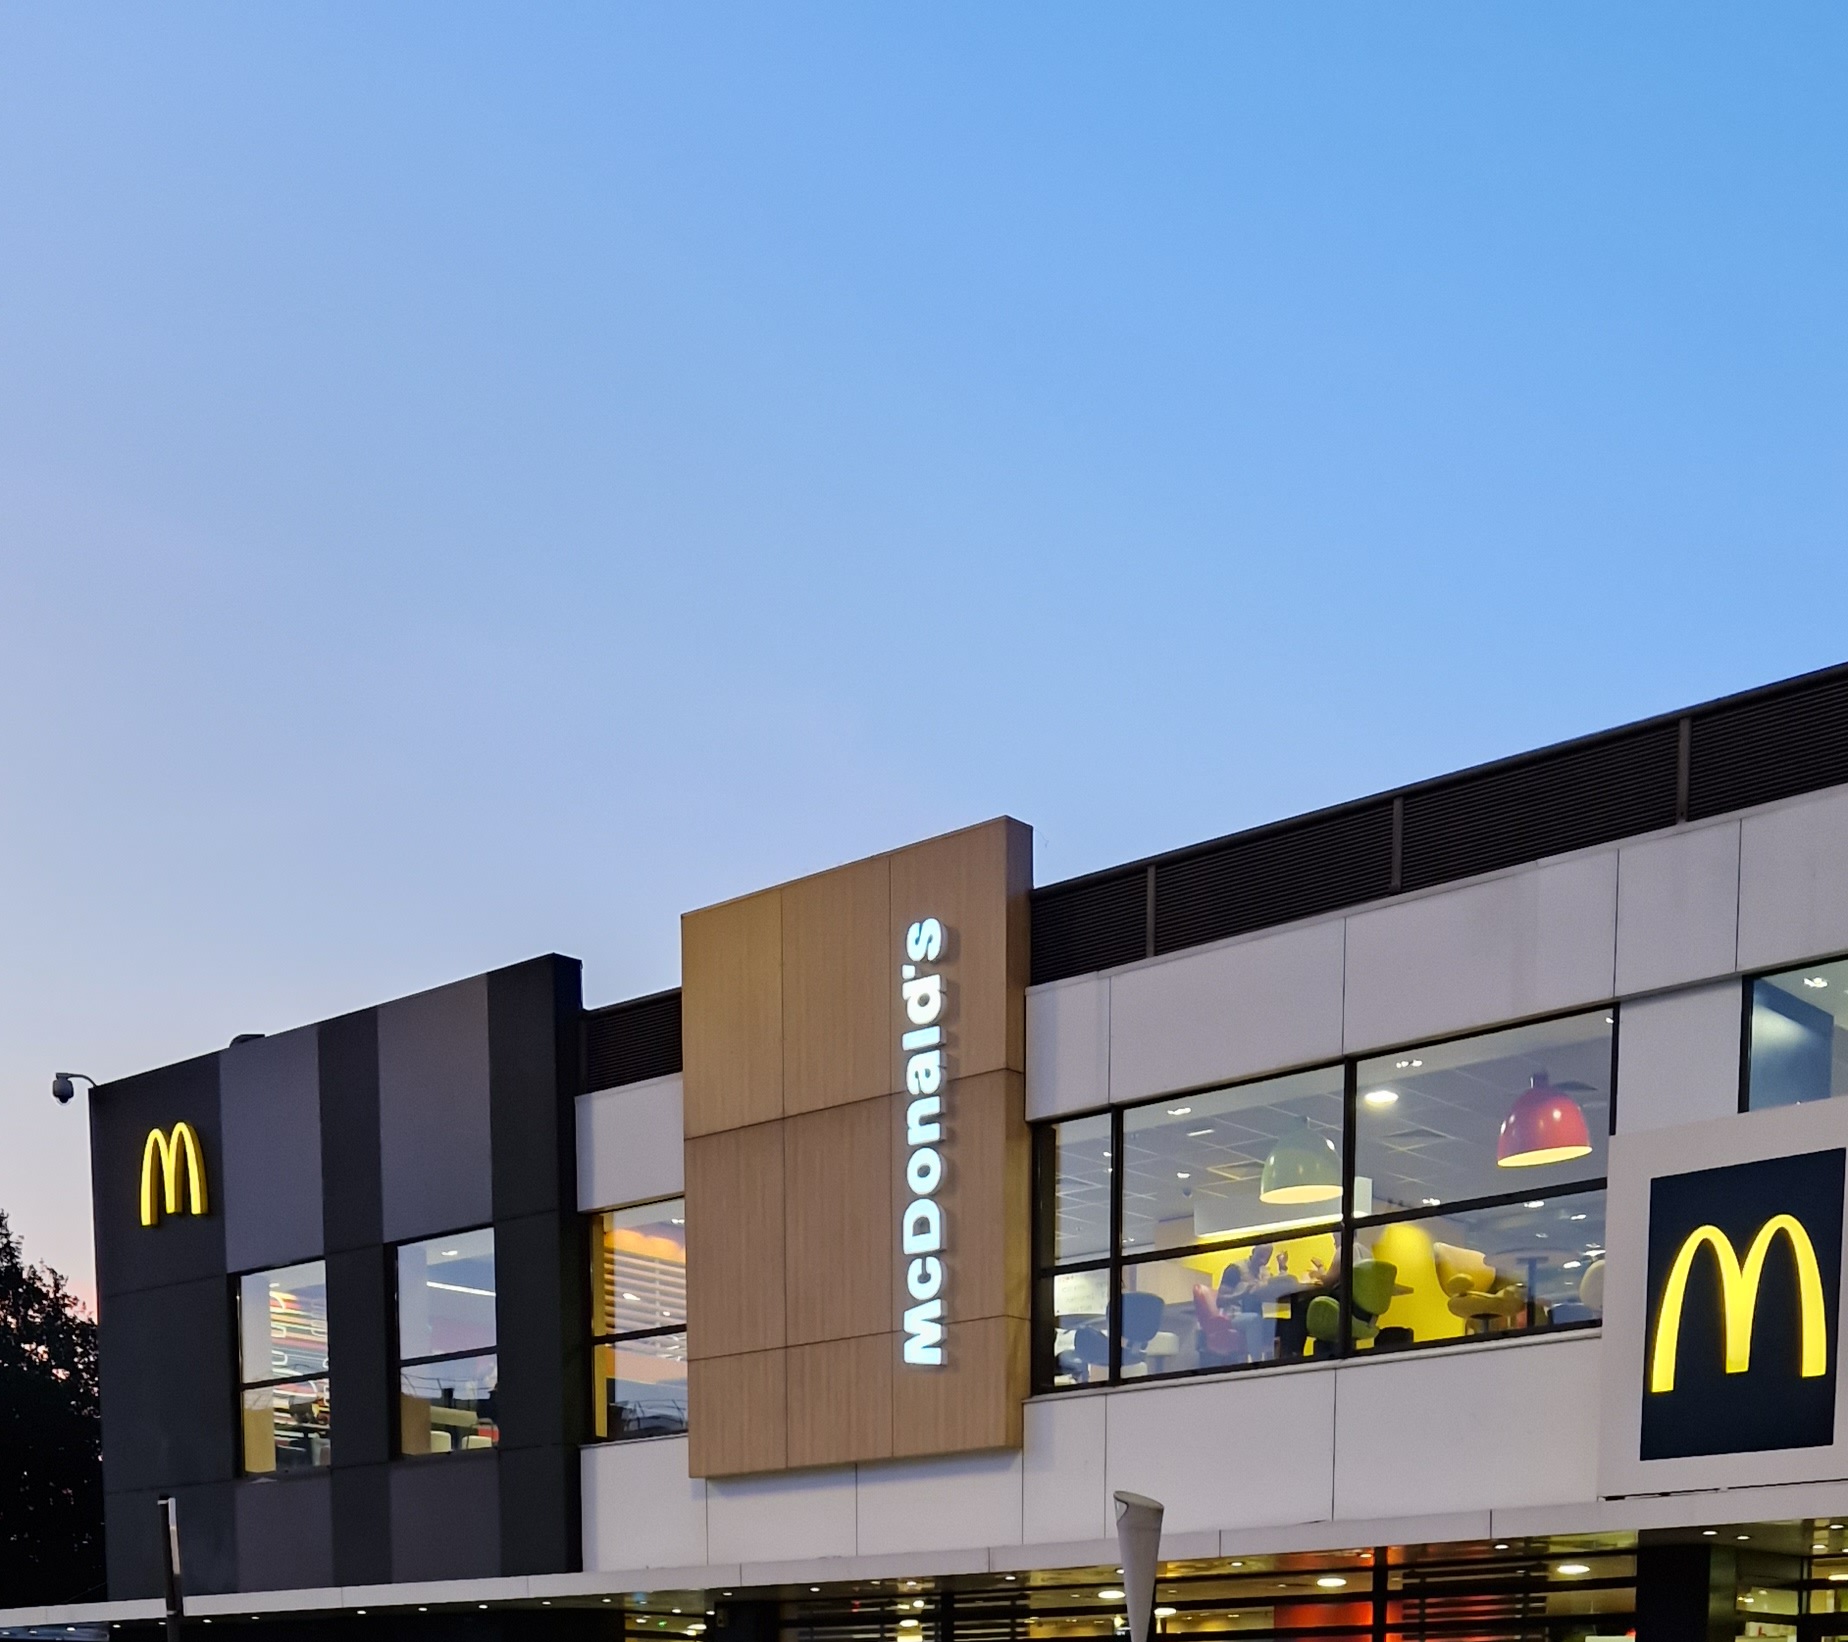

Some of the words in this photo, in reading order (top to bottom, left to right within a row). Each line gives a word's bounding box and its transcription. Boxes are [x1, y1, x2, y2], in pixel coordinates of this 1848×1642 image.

[141, 1122, 208, 1226] M
[902, 917, 947, 1367] McDonald's
[1651, 1214, 1827, 1393] M
